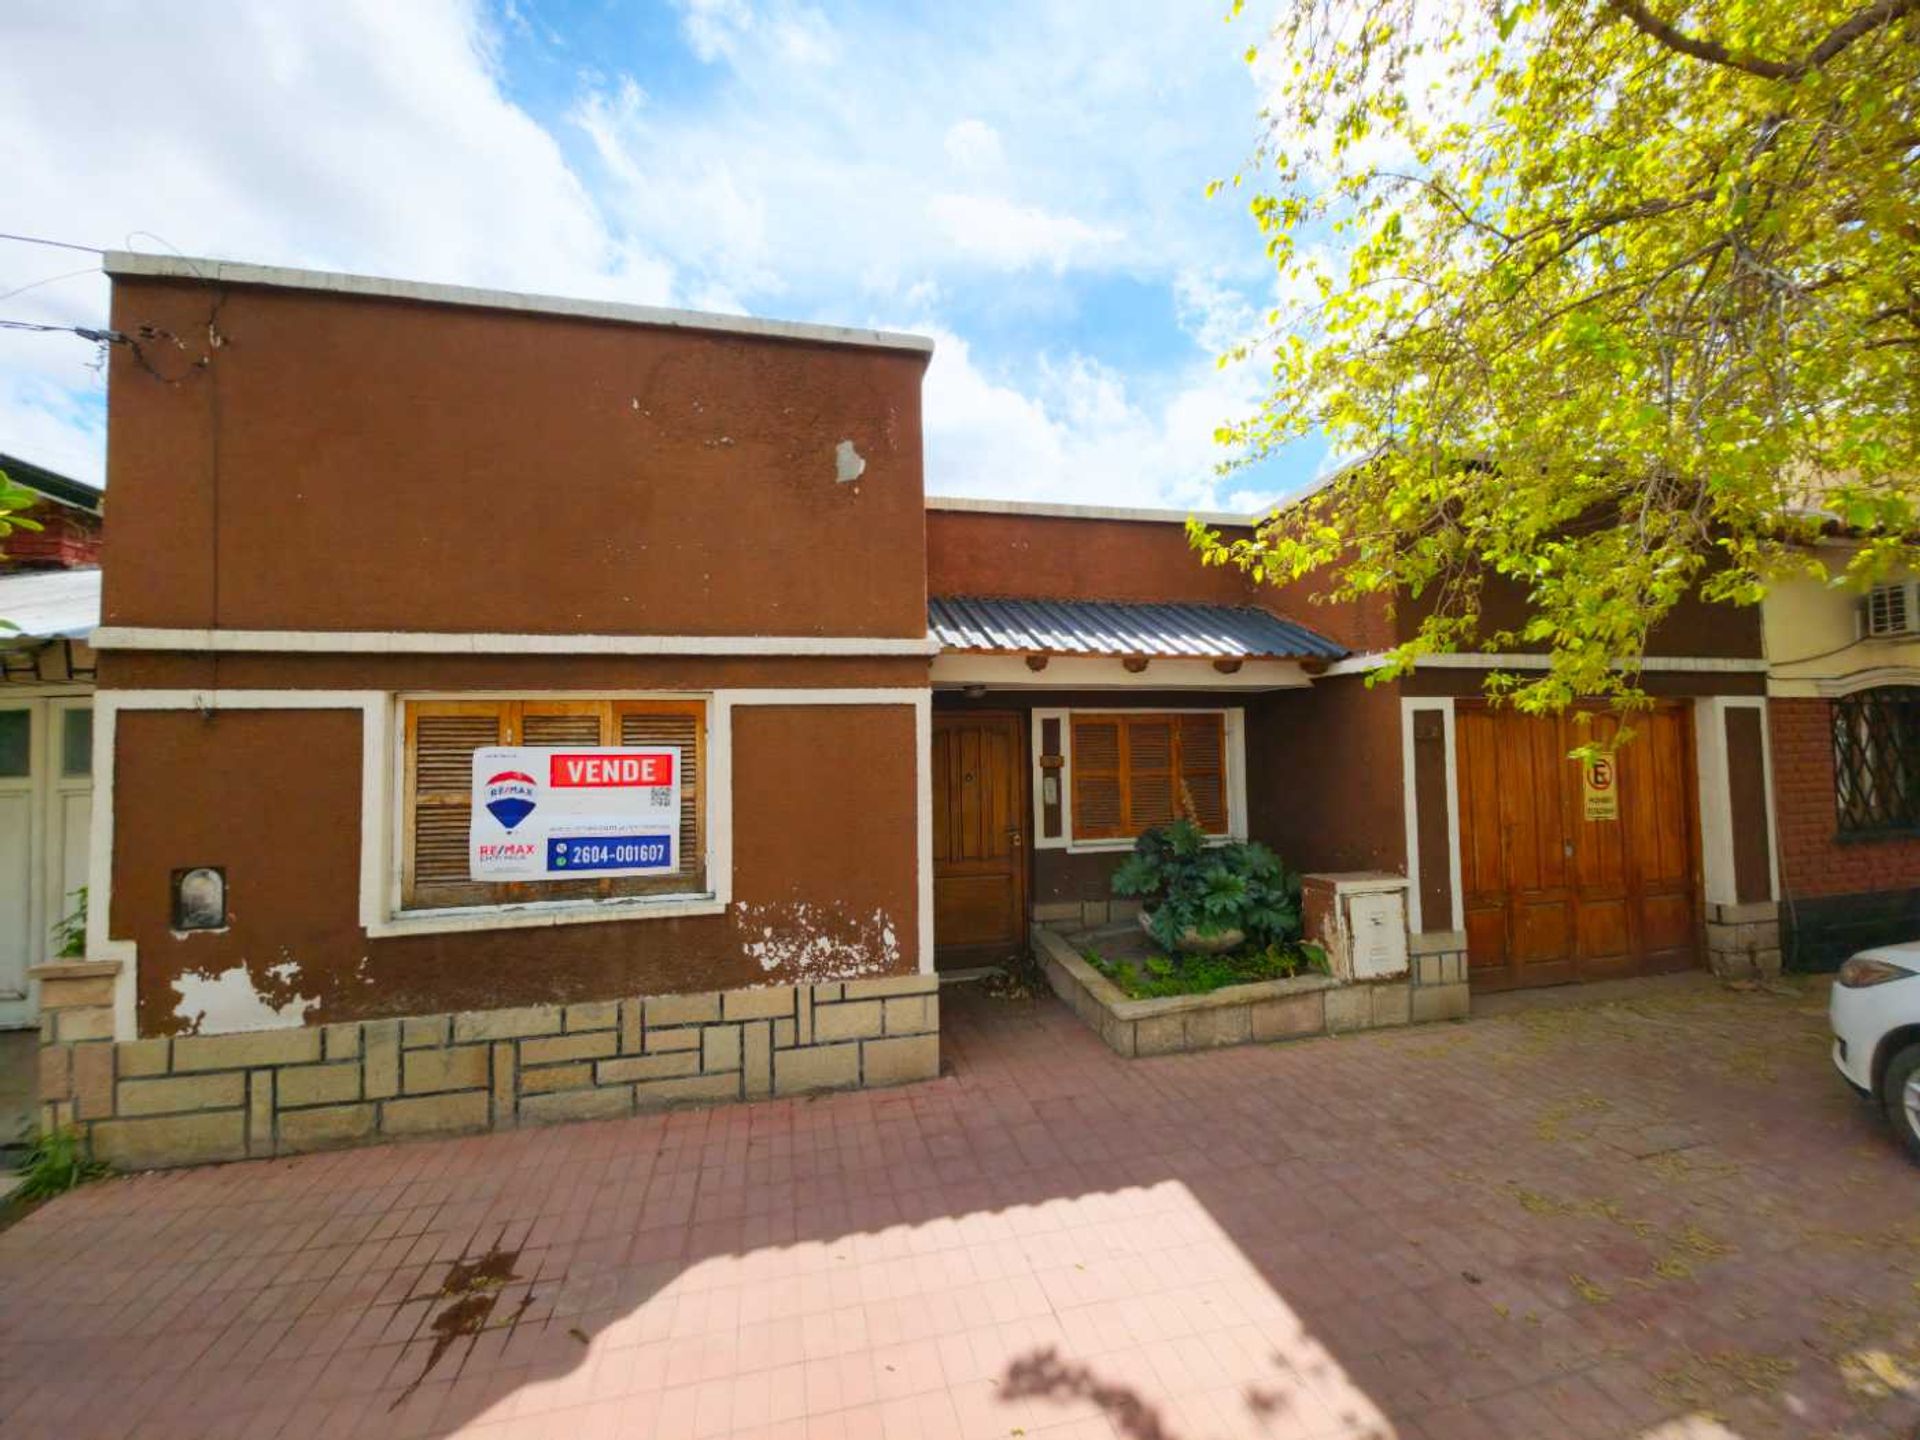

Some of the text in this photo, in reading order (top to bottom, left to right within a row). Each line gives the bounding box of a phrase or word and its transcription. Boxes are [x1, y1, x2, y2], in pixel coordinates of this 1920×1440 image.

[567, 759, 657, 784] VENDE
[479, 844, 536, 856] RE/MAX
[573, 844, 665, 864] 2604-001607
